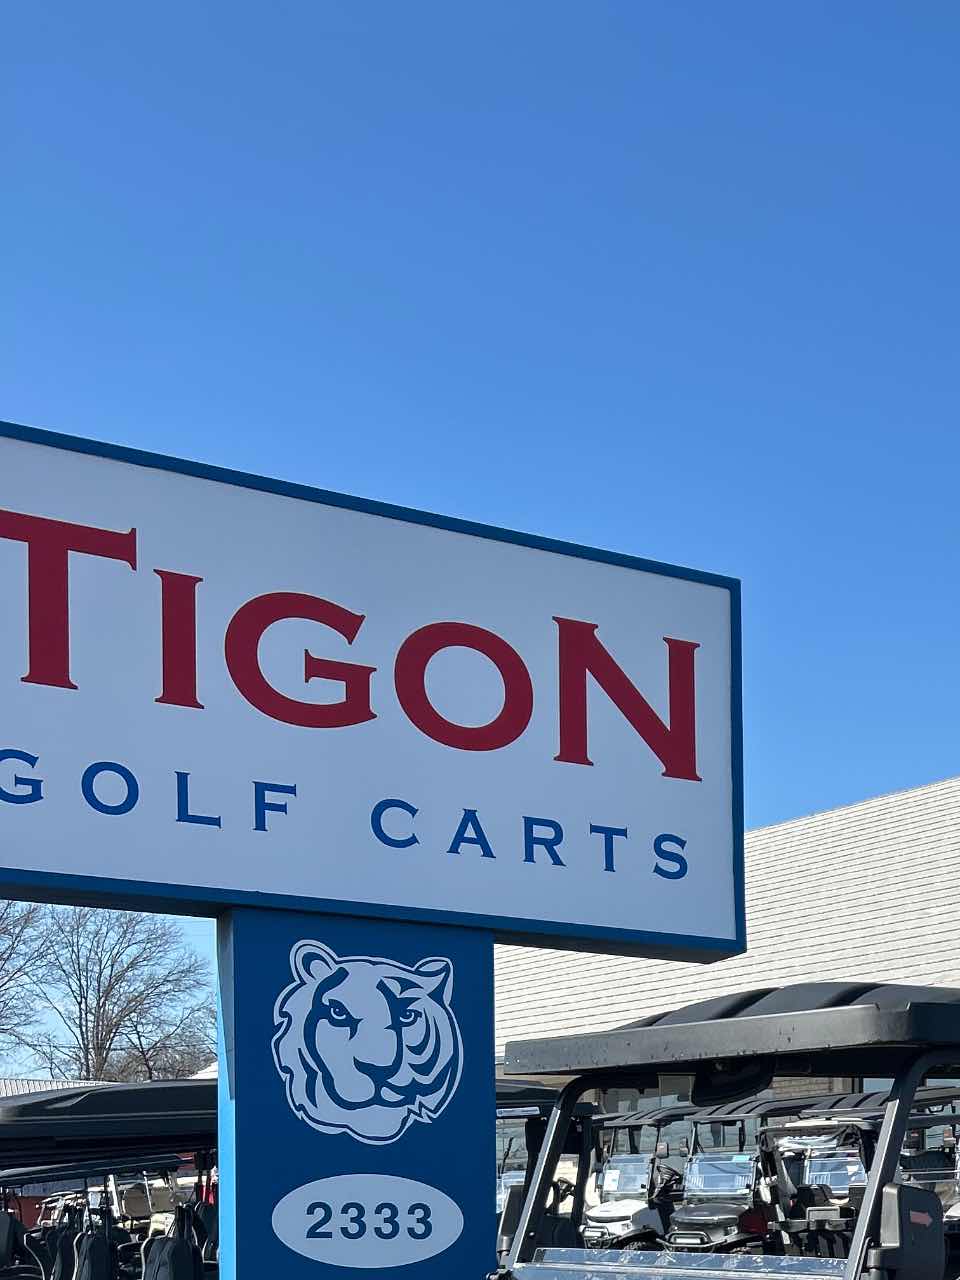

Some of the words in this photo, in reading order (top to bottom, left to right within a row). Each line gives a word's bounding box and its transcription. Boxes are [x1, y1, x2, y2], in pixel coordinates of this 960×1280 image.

[0, 509, 702, 782] TIGON
[0, 748, 297, 832] GOLF
[370, 798, 689, 880] CARTS
[304, 1201, 434, 1241] 2333
